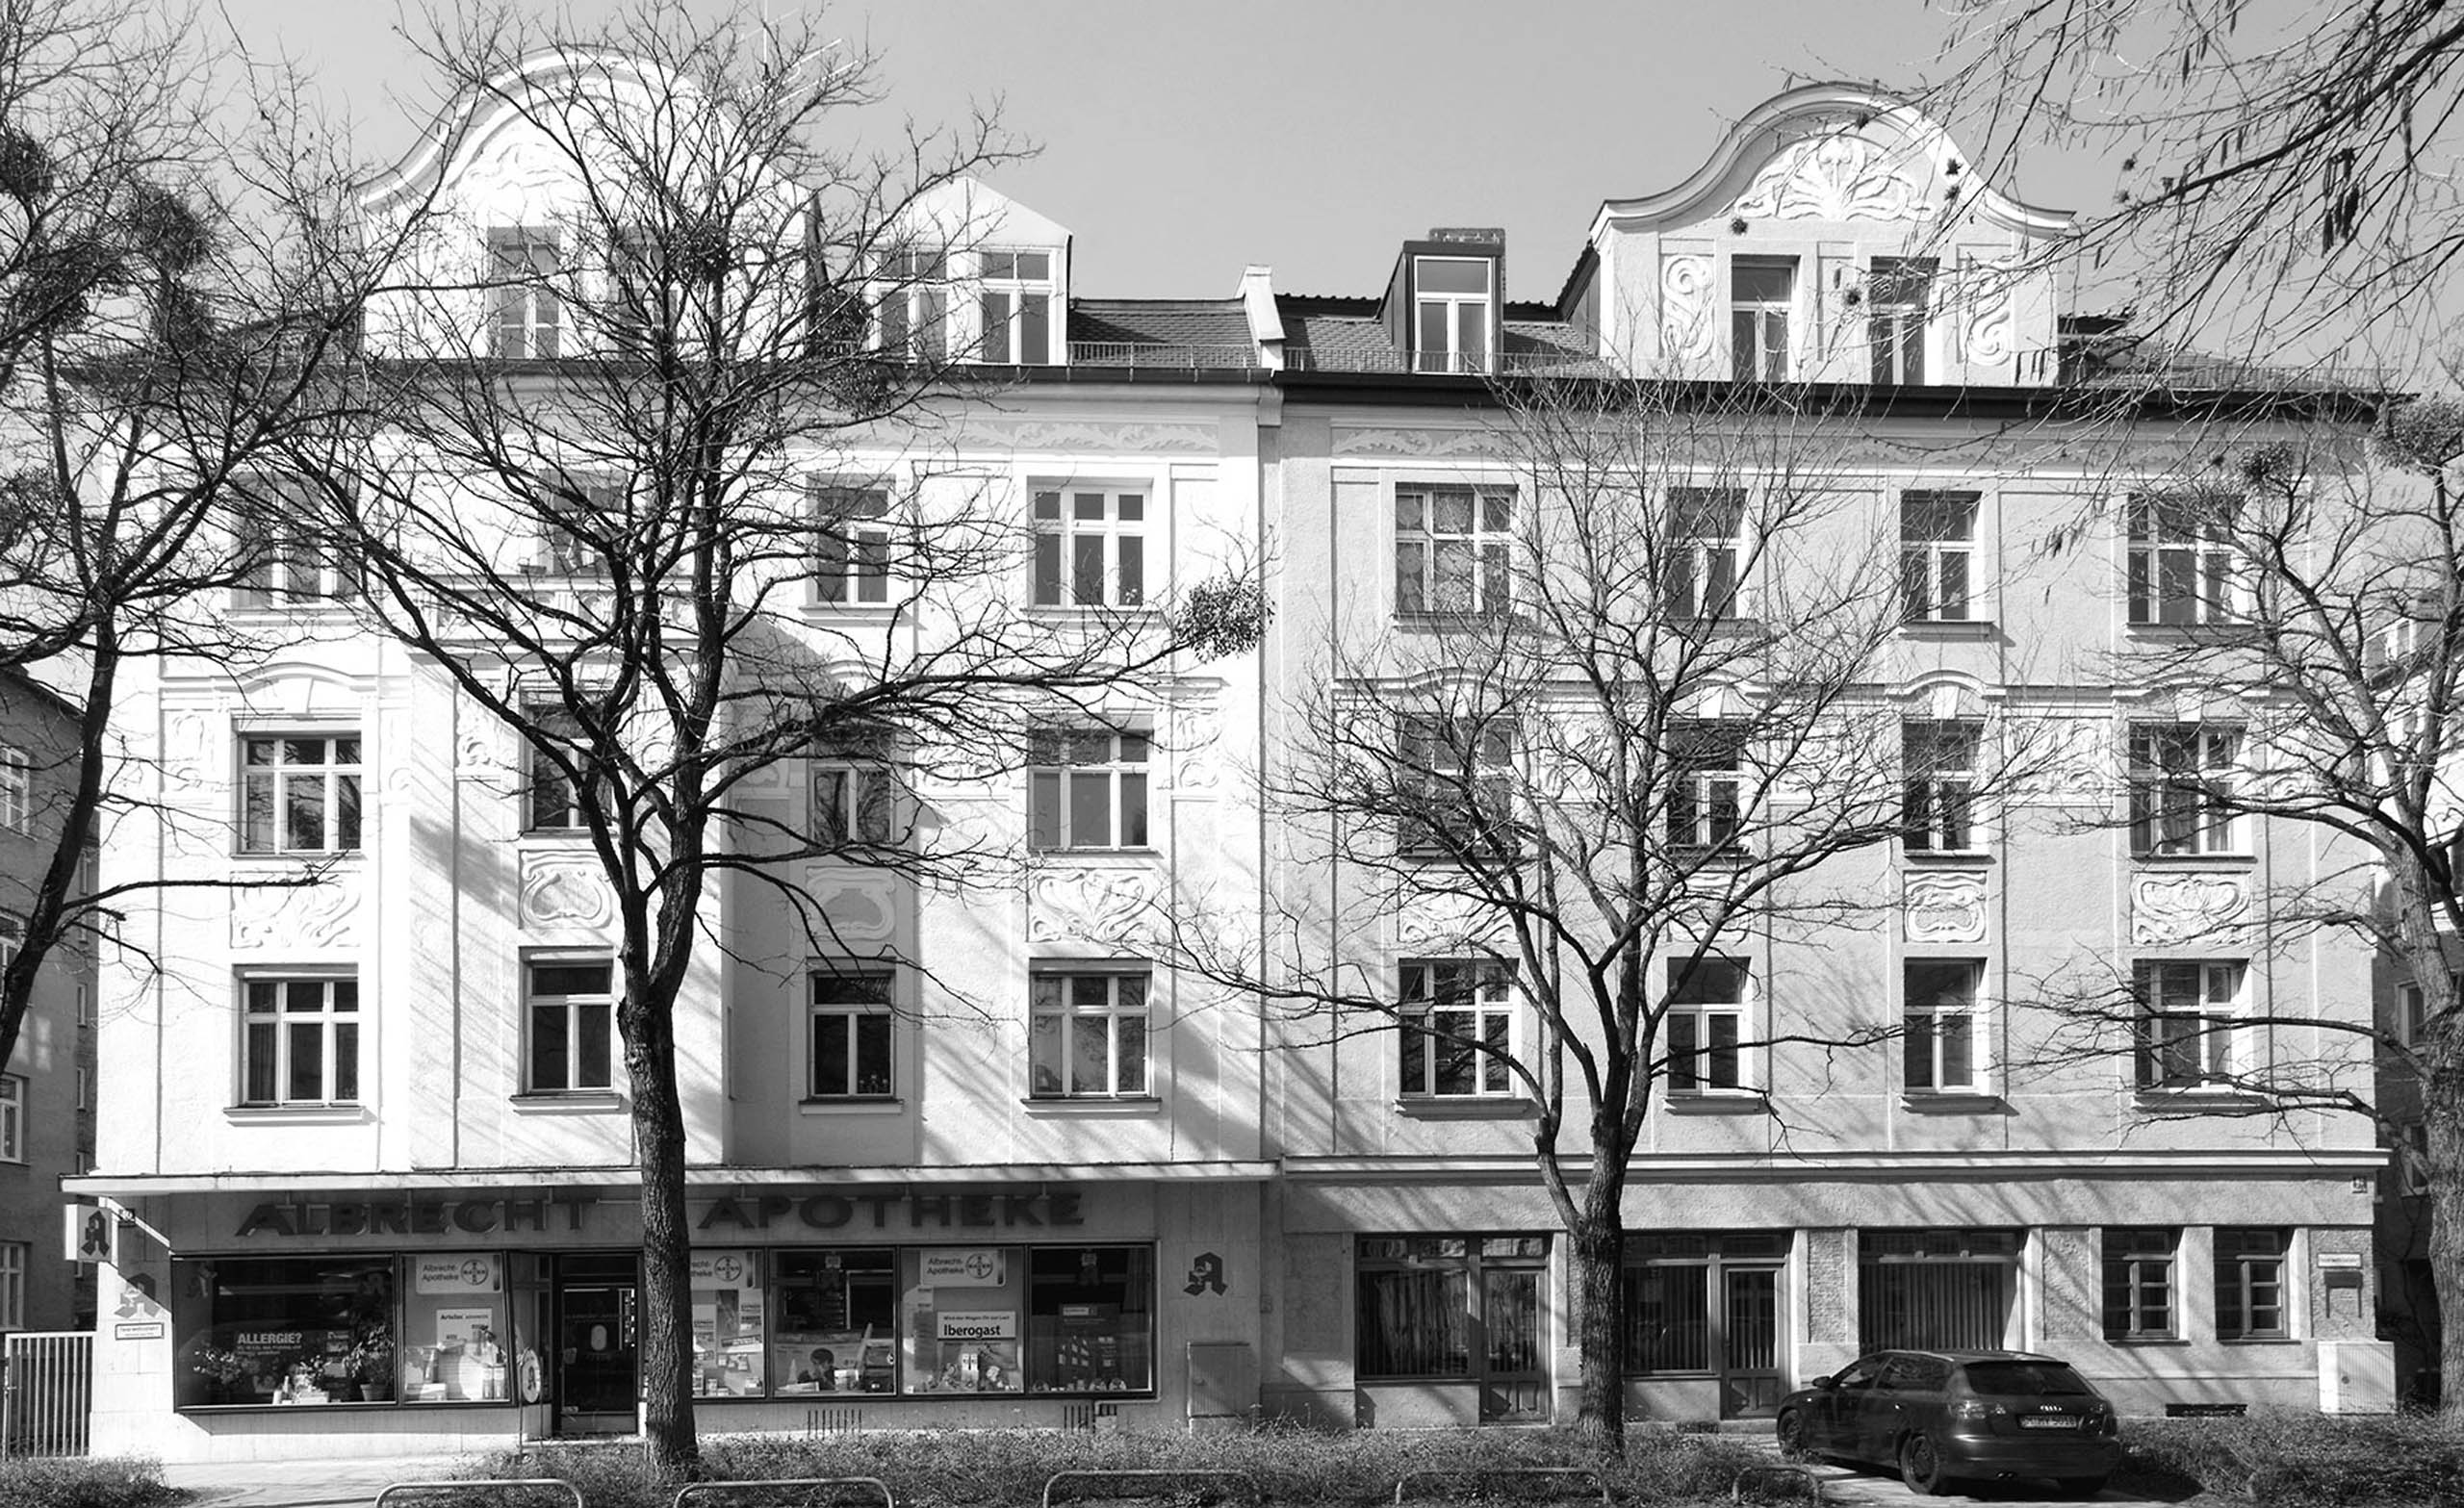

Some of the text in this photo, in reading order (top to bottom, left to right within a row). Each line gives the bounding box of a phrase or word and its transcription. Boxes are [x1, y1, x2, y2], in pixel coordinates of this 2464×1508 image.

[235, 1193, 1085, 1236] ALBRECHT APOTHEKE
[927, 1266, 964, 1275] Apotheke
[943, 1323, 1001, 1339] Iberogast
[238, 1333, 302, 1344] ALLERGIE?
